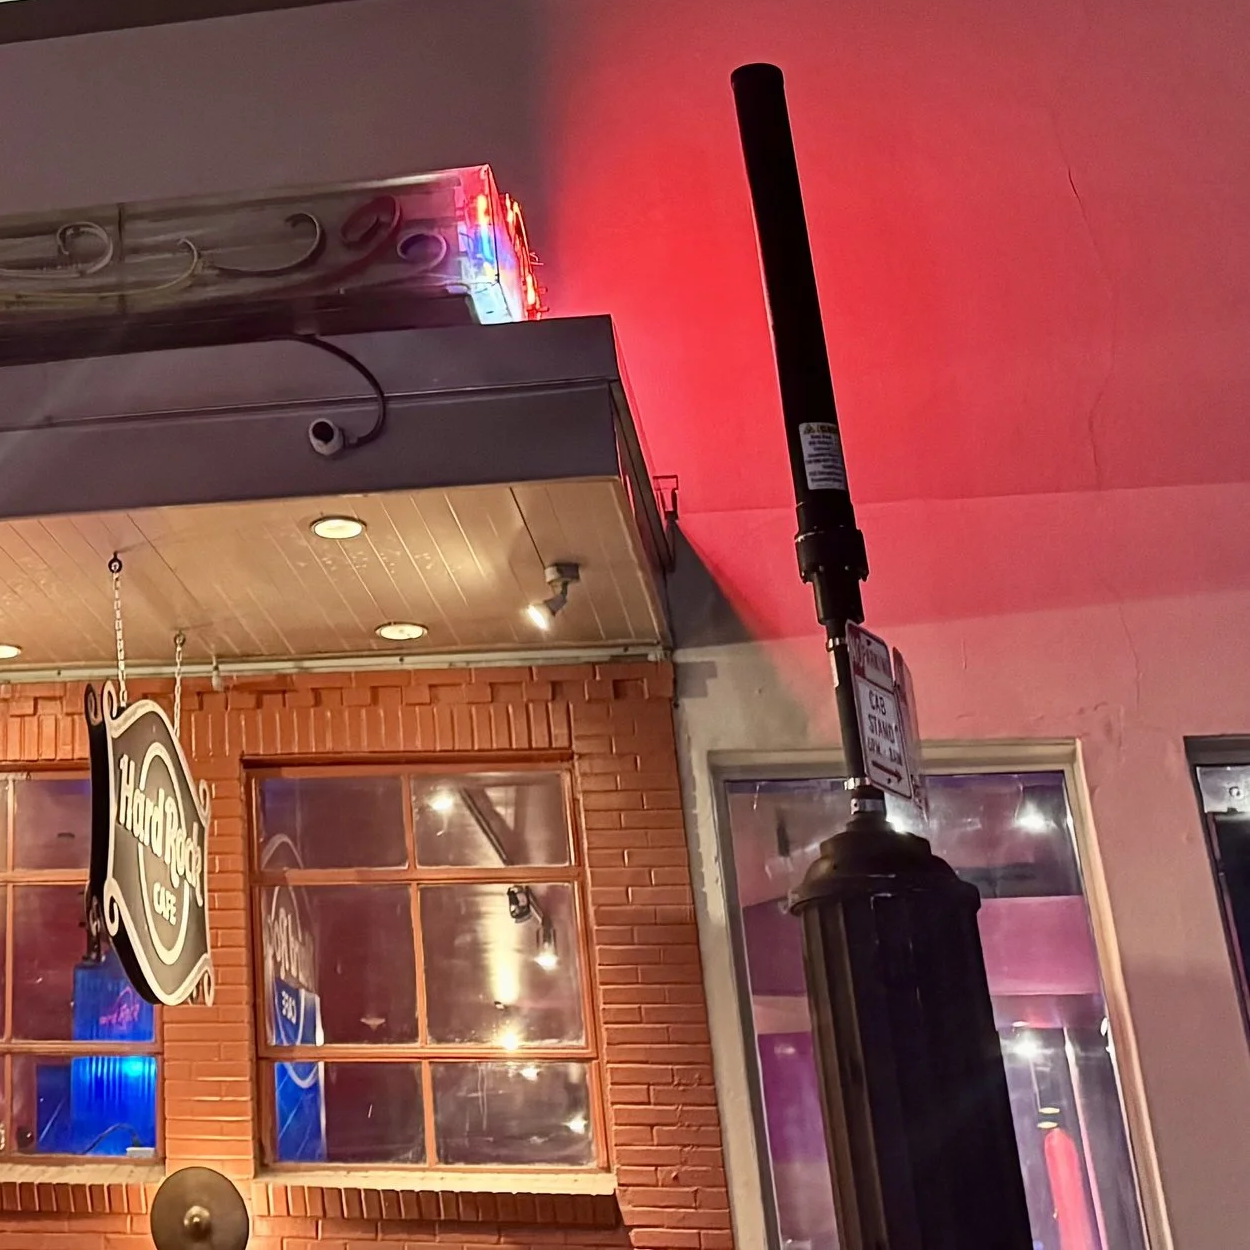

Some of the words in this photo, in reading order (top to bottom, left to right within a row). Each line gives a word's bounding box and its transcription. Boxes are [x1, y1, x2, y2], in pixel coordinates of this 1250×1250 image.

[868, 689, 887, 716] CAB
[118, 753, 166, 858] Hard
[164, 796, 204, 908] Rock
[153, 882, 177, 926] CAFE
